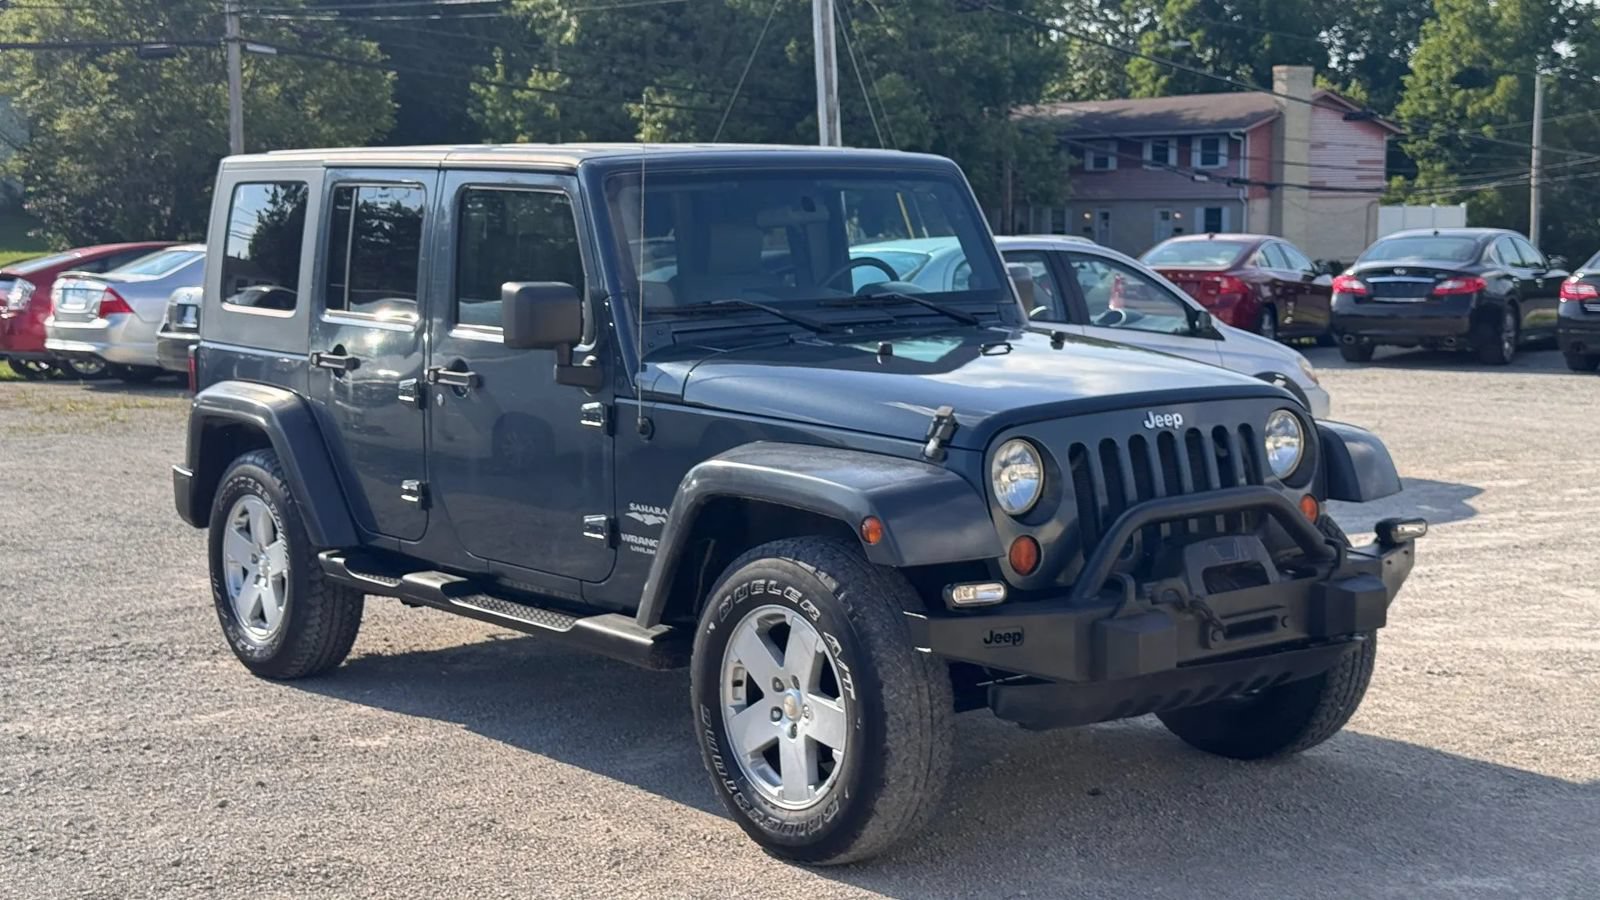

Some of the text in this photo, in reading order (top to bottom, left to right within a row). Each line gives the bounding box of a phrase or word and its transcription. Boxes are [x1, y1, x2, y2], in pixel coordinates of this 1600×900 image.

[1143, 411, 1183, 429] Jeep
[629, 502, 669, 517] SAHARA
[718, 579, 822, 623] DUELER
[983, 629, 1023, 646] Jeep
